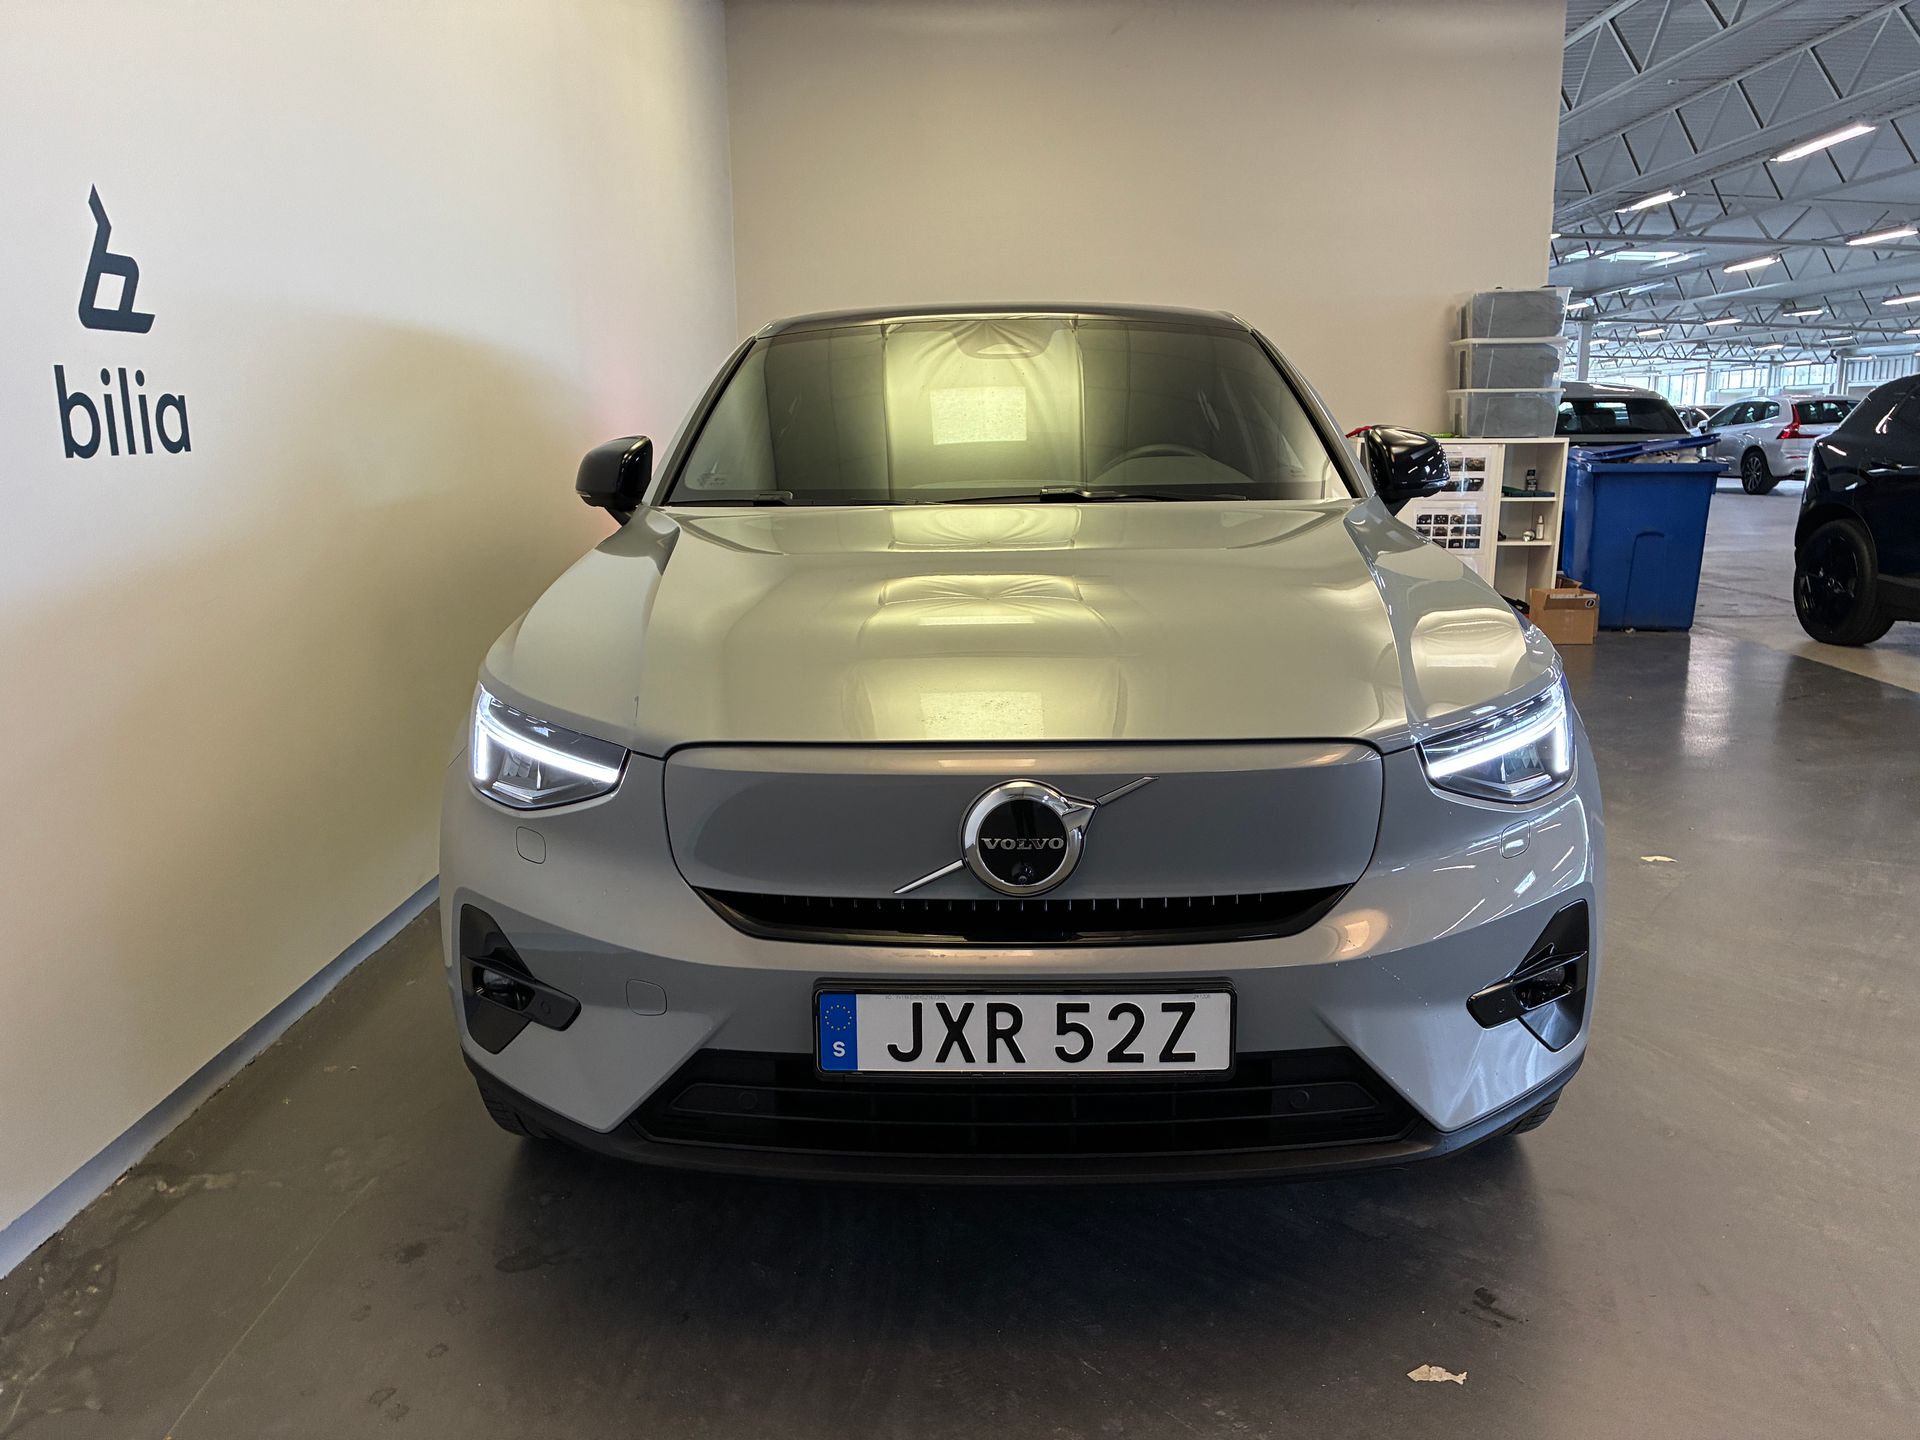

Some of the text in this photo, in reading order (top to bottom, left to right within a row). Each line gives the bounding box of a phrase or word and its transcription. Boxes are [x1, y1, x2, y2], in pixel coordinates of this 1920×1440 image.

[53, 365, 191, 459] bilia
[981, 838, 1064, 850] VOLVO
[832, 1041, 845, 1057] S
[887, 1001, 1197, 1063] JXR 52Z
